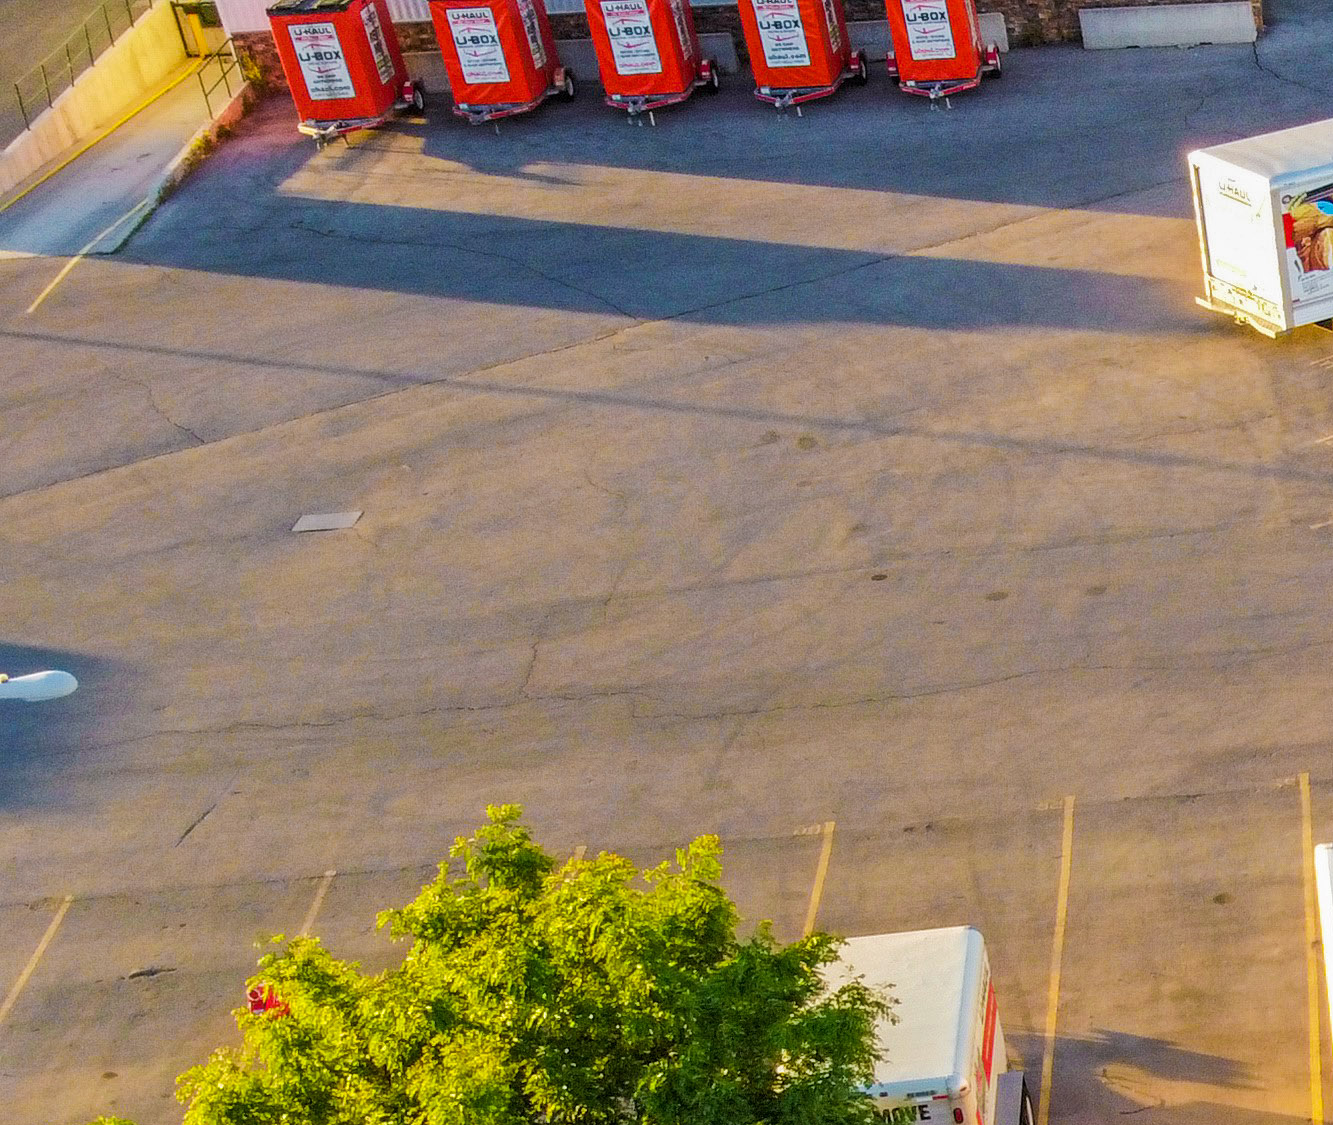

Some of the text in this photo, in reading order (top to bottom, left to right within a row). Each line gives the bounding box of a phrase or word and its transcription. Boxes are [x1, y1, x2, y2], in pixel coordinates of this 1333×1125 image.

[906, 12, 947, 22] U-BOX
[759, 20, 801, 30] U-BOX
[293, 27, 332, 36] U-HAUL
[609, 26, 651, 37] U-BOX
[455, 34, 499, 45] U-BOX
[298, 51, 342, 62] U-BOX
